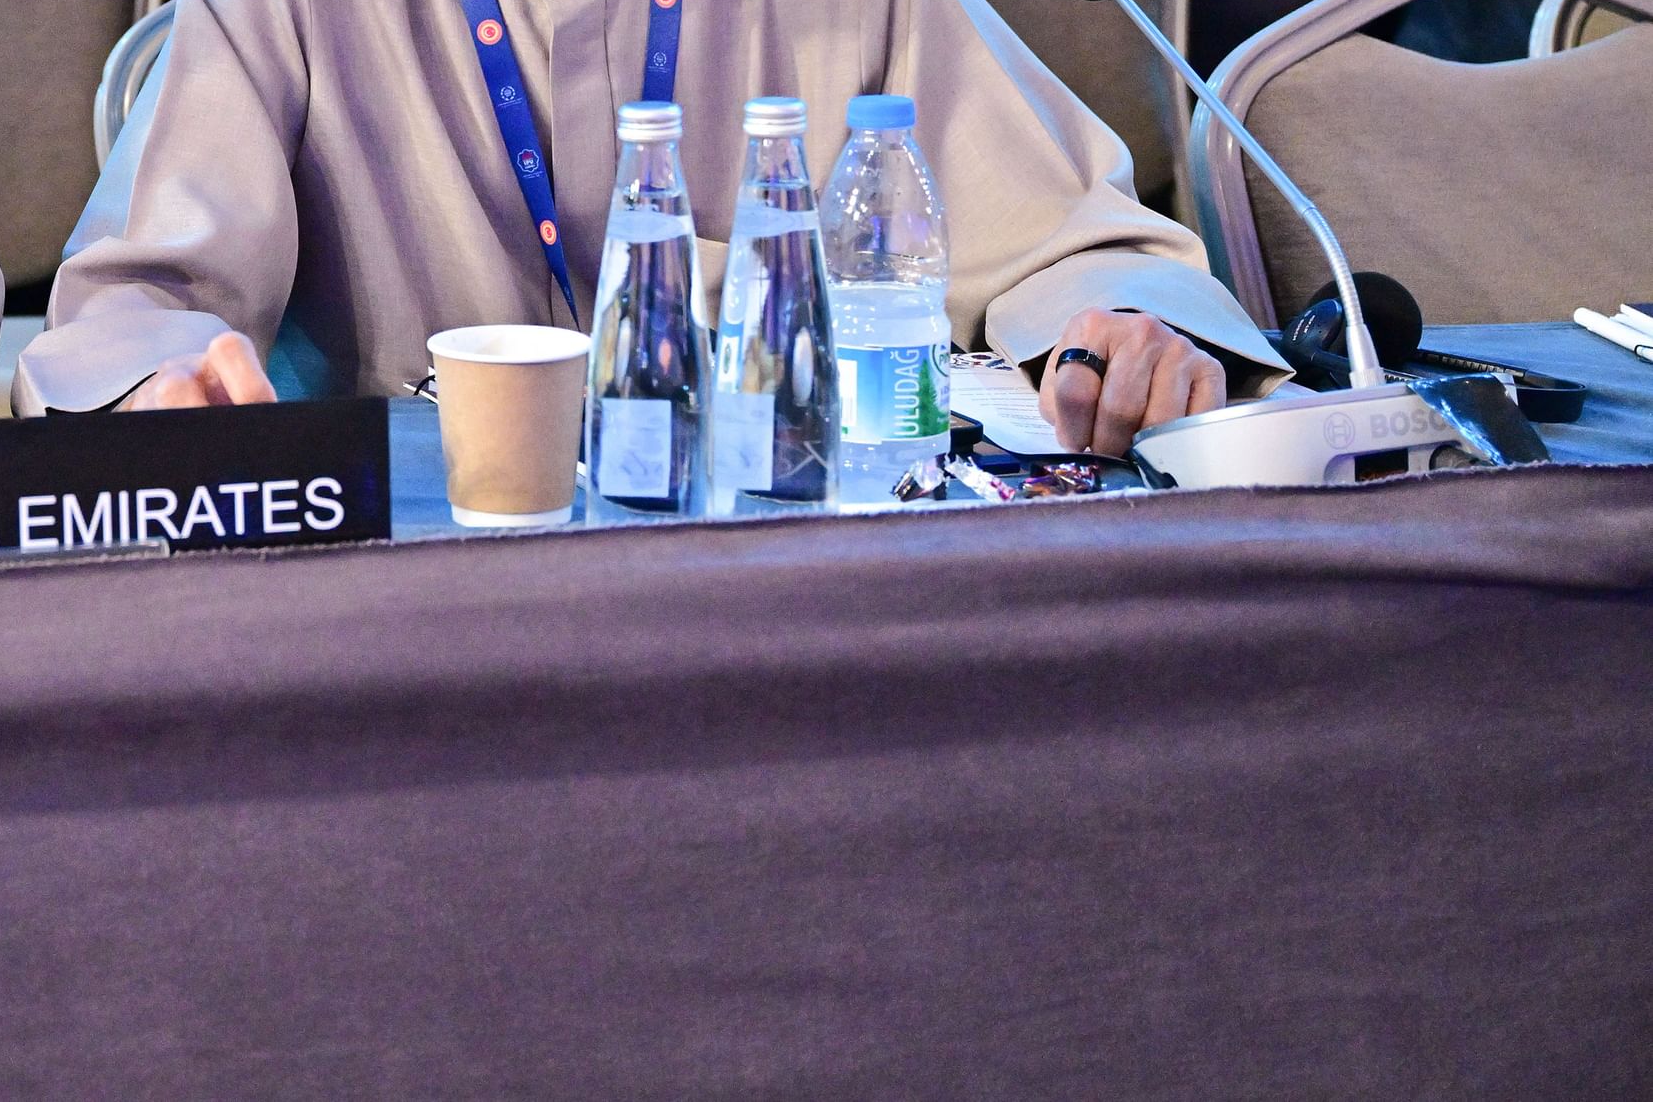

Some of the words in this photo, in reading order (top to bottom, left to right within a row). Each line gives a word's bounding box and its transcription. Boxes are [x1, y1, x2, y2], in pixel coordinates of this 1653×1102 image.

[890, 348, 920, 436] ULUDAĞ
[1369, 408, 1450, 439] BOSC
[18, 477, 345, 553] EMIRATES
